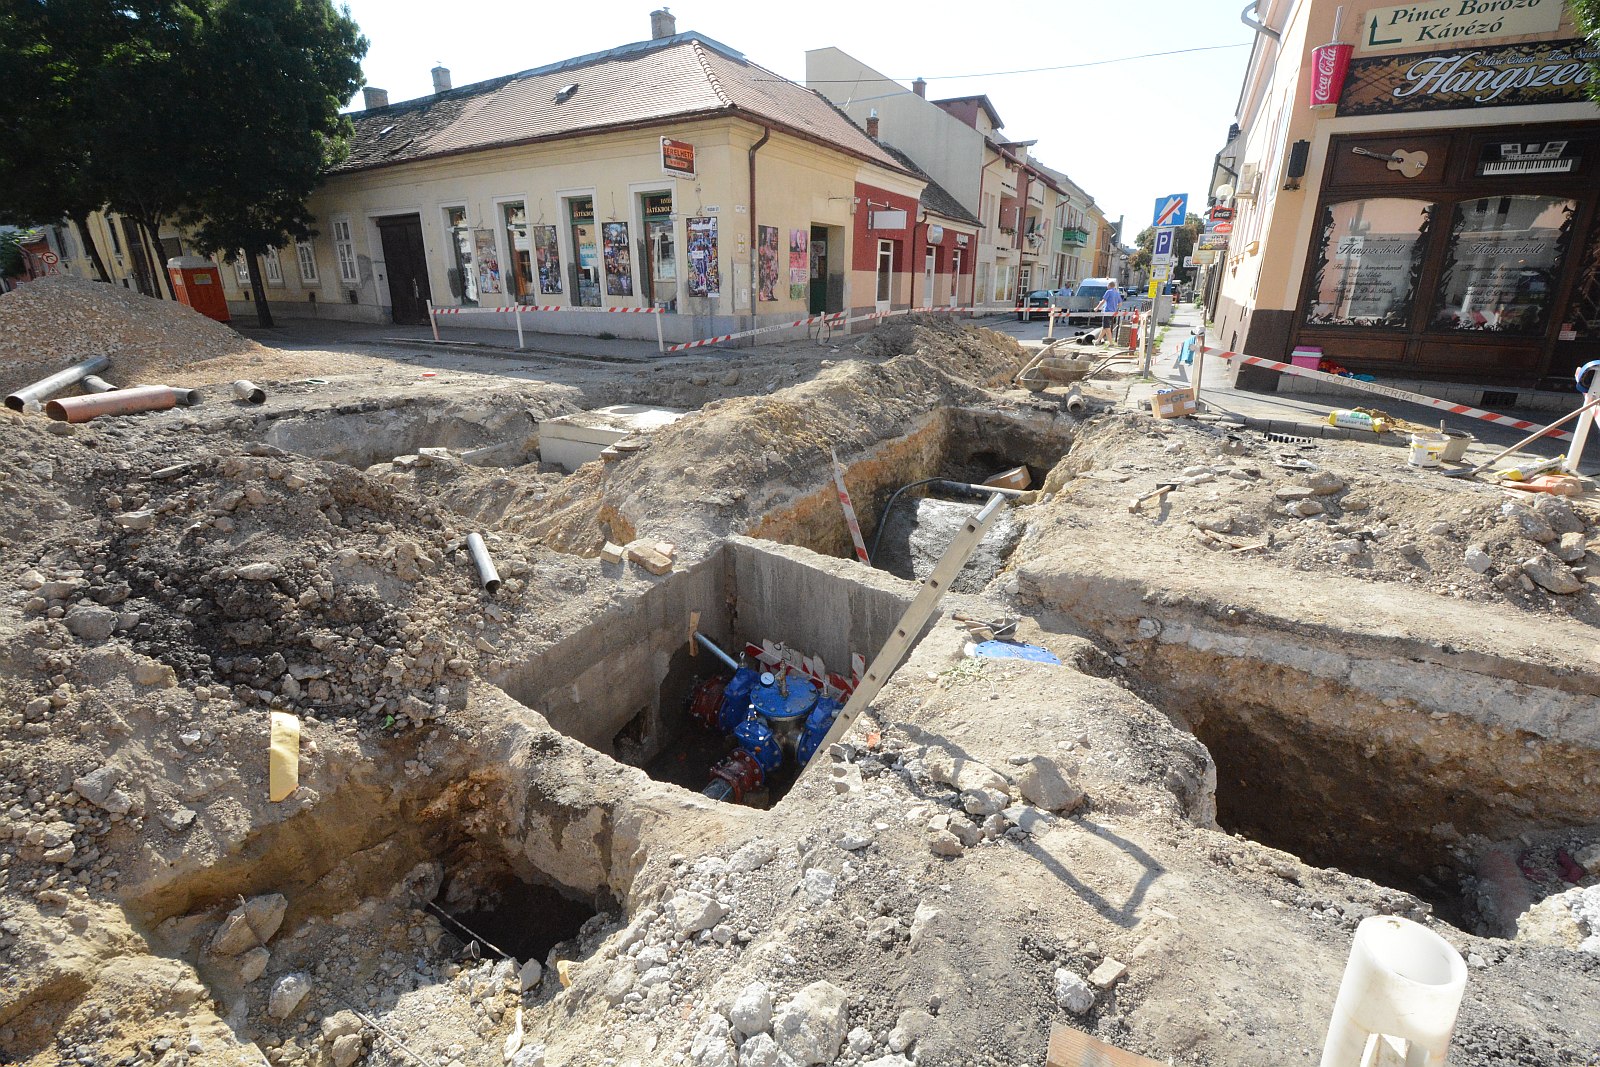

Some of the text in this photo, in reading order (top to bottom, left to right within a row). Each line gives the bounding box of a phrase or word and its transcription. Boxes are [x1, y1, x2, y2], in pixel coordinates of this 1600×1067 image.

[1388, 7, 1450, 25] Pince
[1415, 17, 1504, 42] Kávézó
[1159, 234, 1168, 252] P
